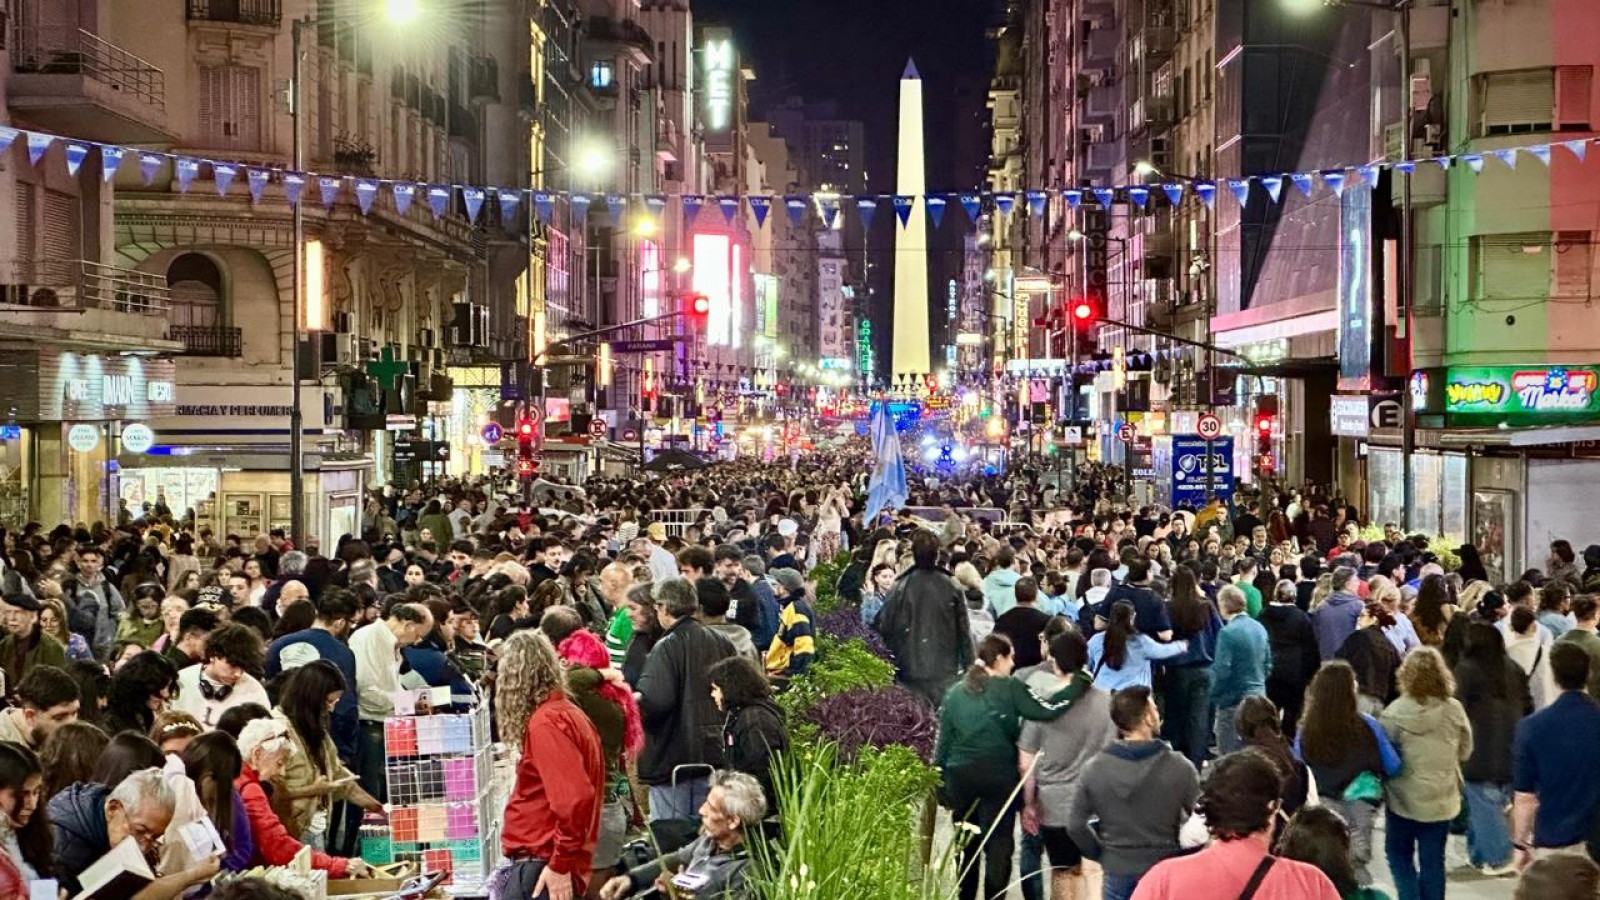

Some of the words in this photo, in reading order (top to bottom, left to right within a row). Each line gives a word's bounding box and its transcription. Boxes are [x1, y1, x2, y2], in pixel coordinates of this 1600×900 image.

[704, 39, 732, 130] MET
[1518, 385, 1588, 409] Market
[1202, 421, 1217, 432] 30
[1379, 405, 1398, 427] E
